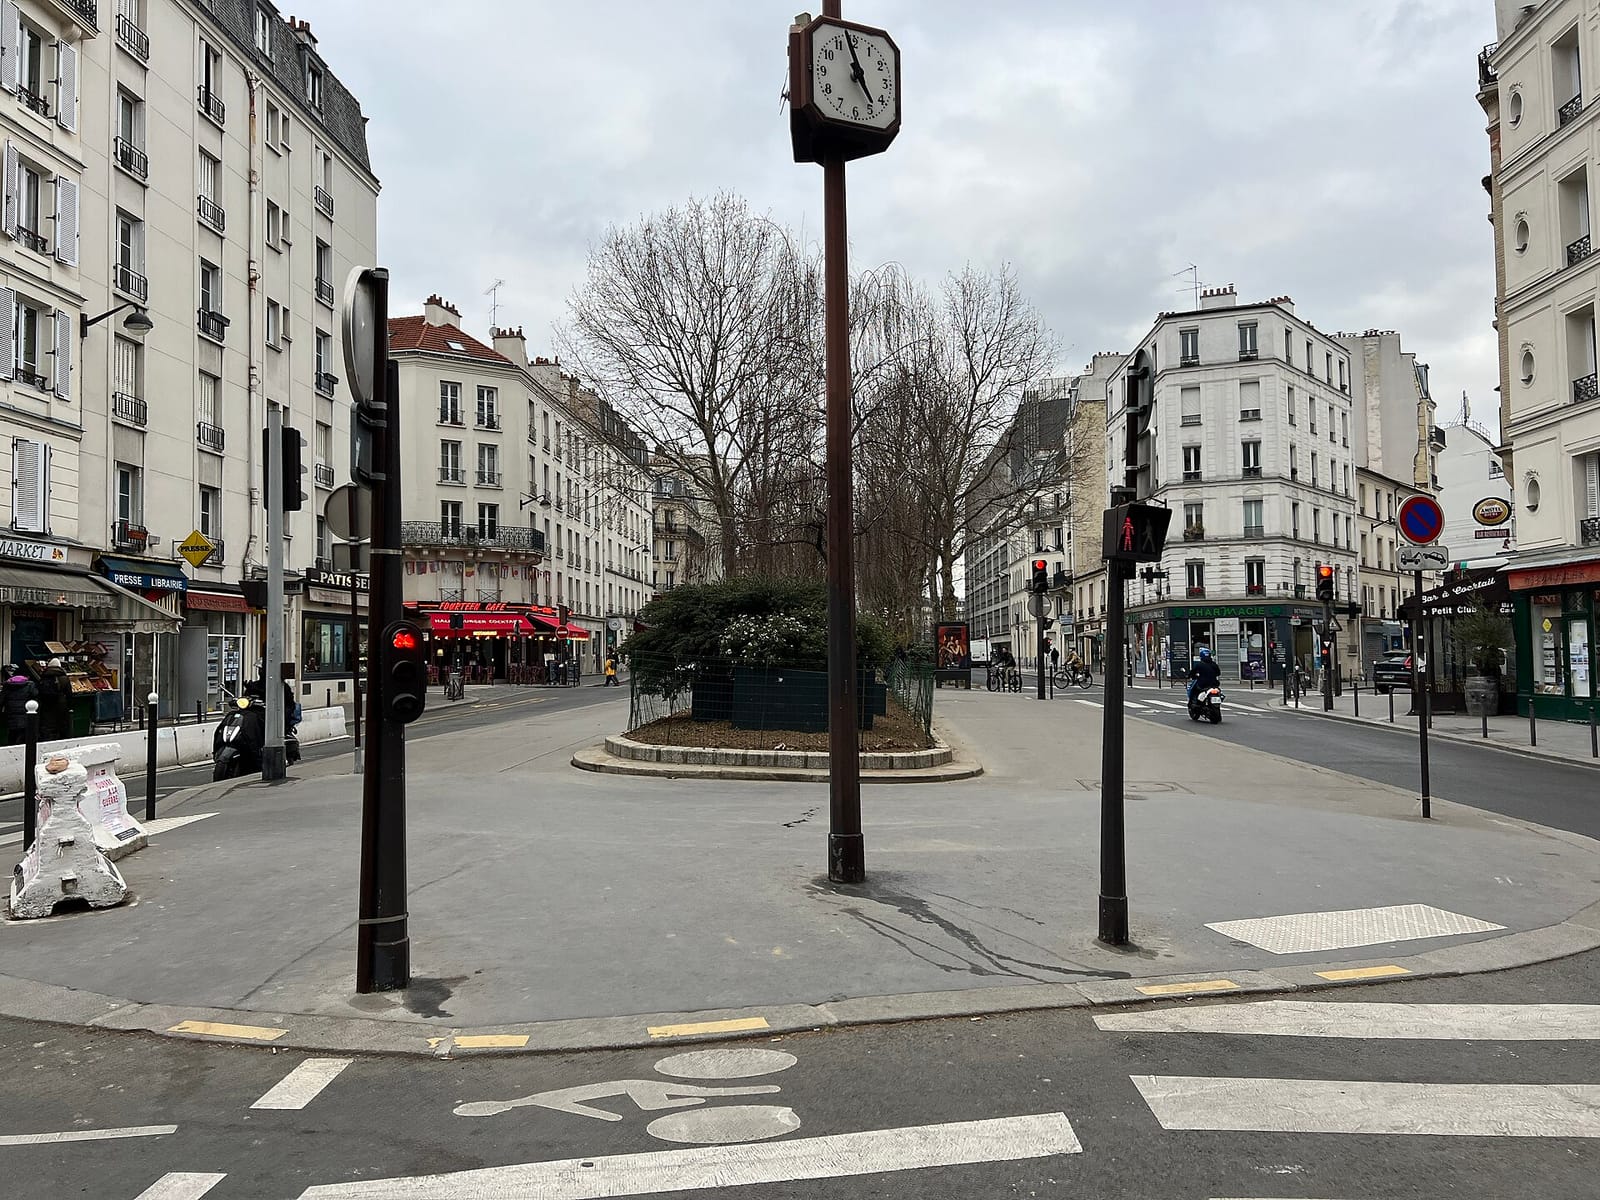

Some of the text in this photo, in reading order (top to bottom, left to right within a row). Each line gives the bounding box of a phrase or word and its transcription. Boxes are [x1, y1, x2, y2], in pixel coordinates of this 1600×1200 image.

[834, 39, 843, 51] 11
[823, 49, 834, 61] 10
[866, 47, 871, 57] 1
[820, 65, 827, 77] 9
[877, 60, 884, 72] 2
[824, 83, 832, 95] 8
[882, 78, 889, 90] 3
[837, 97, 844, 109] 7
[877, 94, 885, 105] 4
[852, 106, 859, 118] 6
[867, 104, 873, 115] 5
[114, 574, 183, 589] PRESSE LIBRAIRIE
[320, 571, 370, 590] PATISSE
[1452, 578, 1495, 595] Cocktail
[439, 602, 481, 611] FOURTEEN
[1189, 608, 1265, 616] PHARMACIE
[1432, 606, 1452, 615] Petit
[1457, 606, 1477, 614] Club
